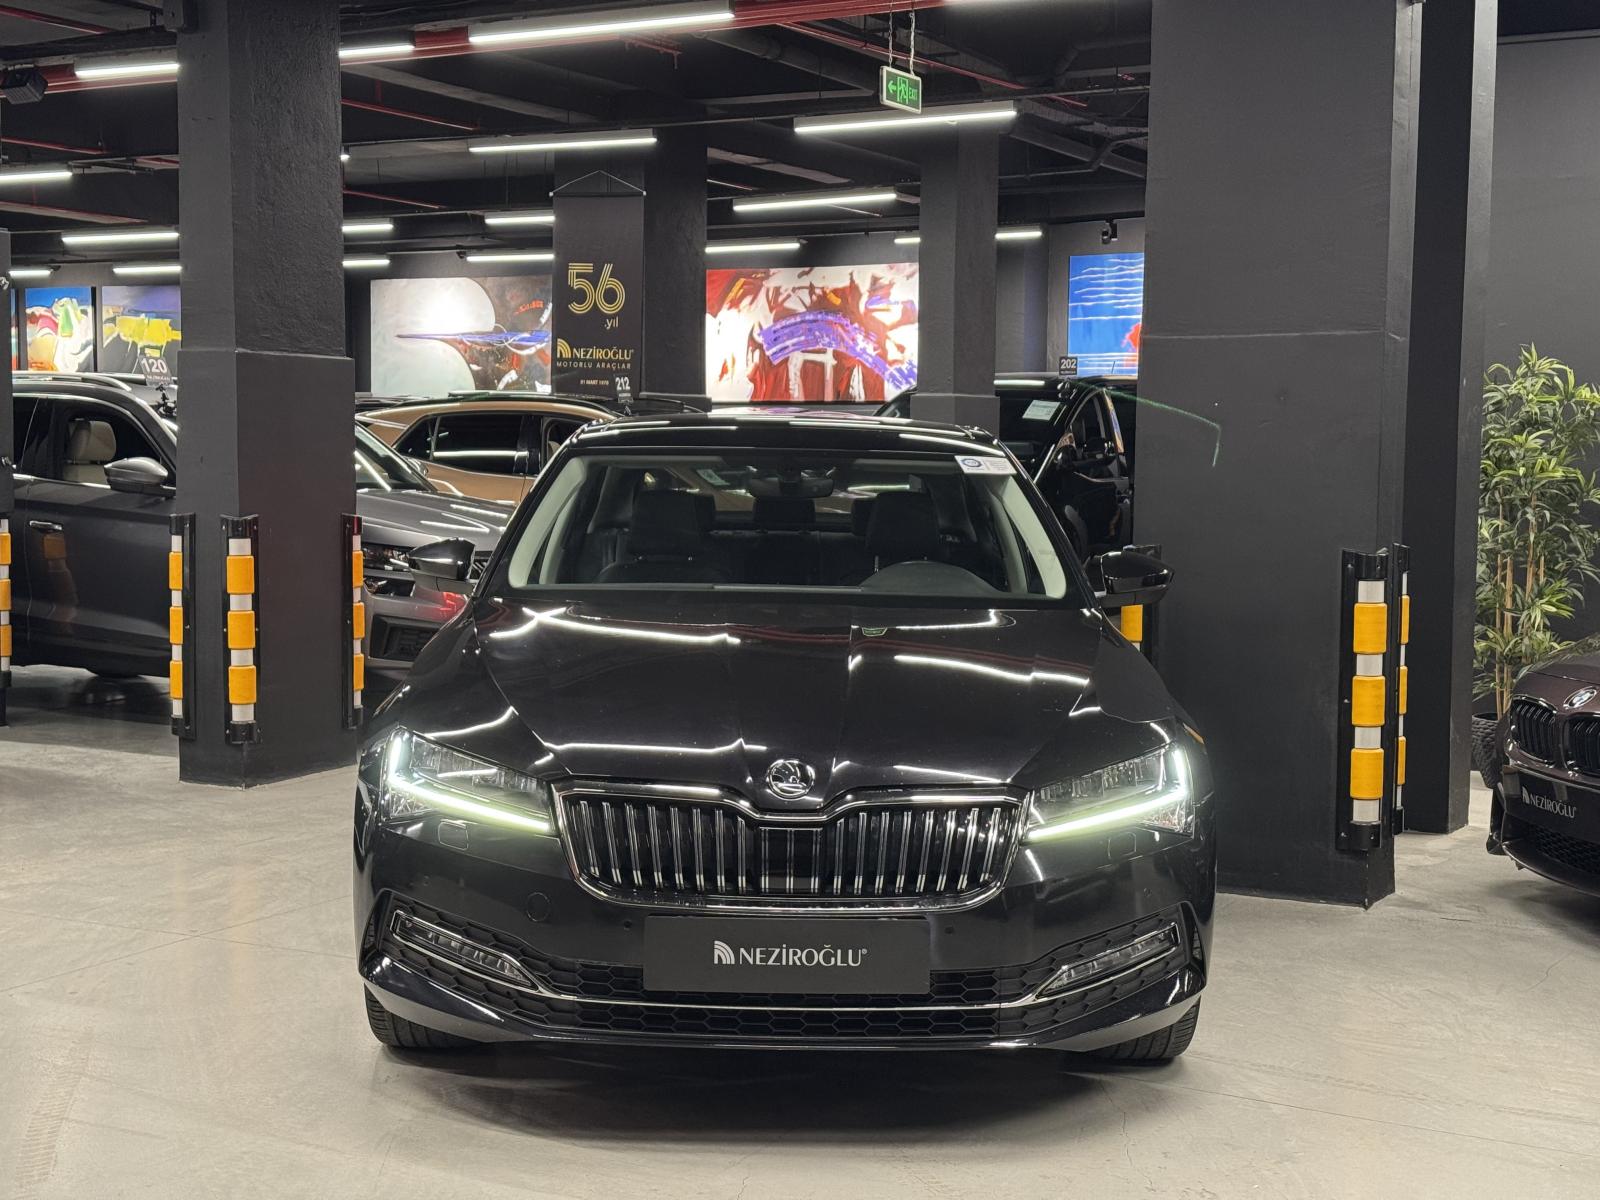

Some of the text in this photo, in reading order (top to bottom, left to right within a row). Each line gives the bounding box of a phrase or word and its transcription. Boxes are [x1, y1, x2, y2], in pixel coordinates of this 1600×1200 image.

[568, 263, 626, 314] 56
[141, 357, 168, 374] 120
[596, 362, 631, 371] ARAÇLAR
[1060, 358, 1077, 369] 202
[615, 376, 631, 391] 212
